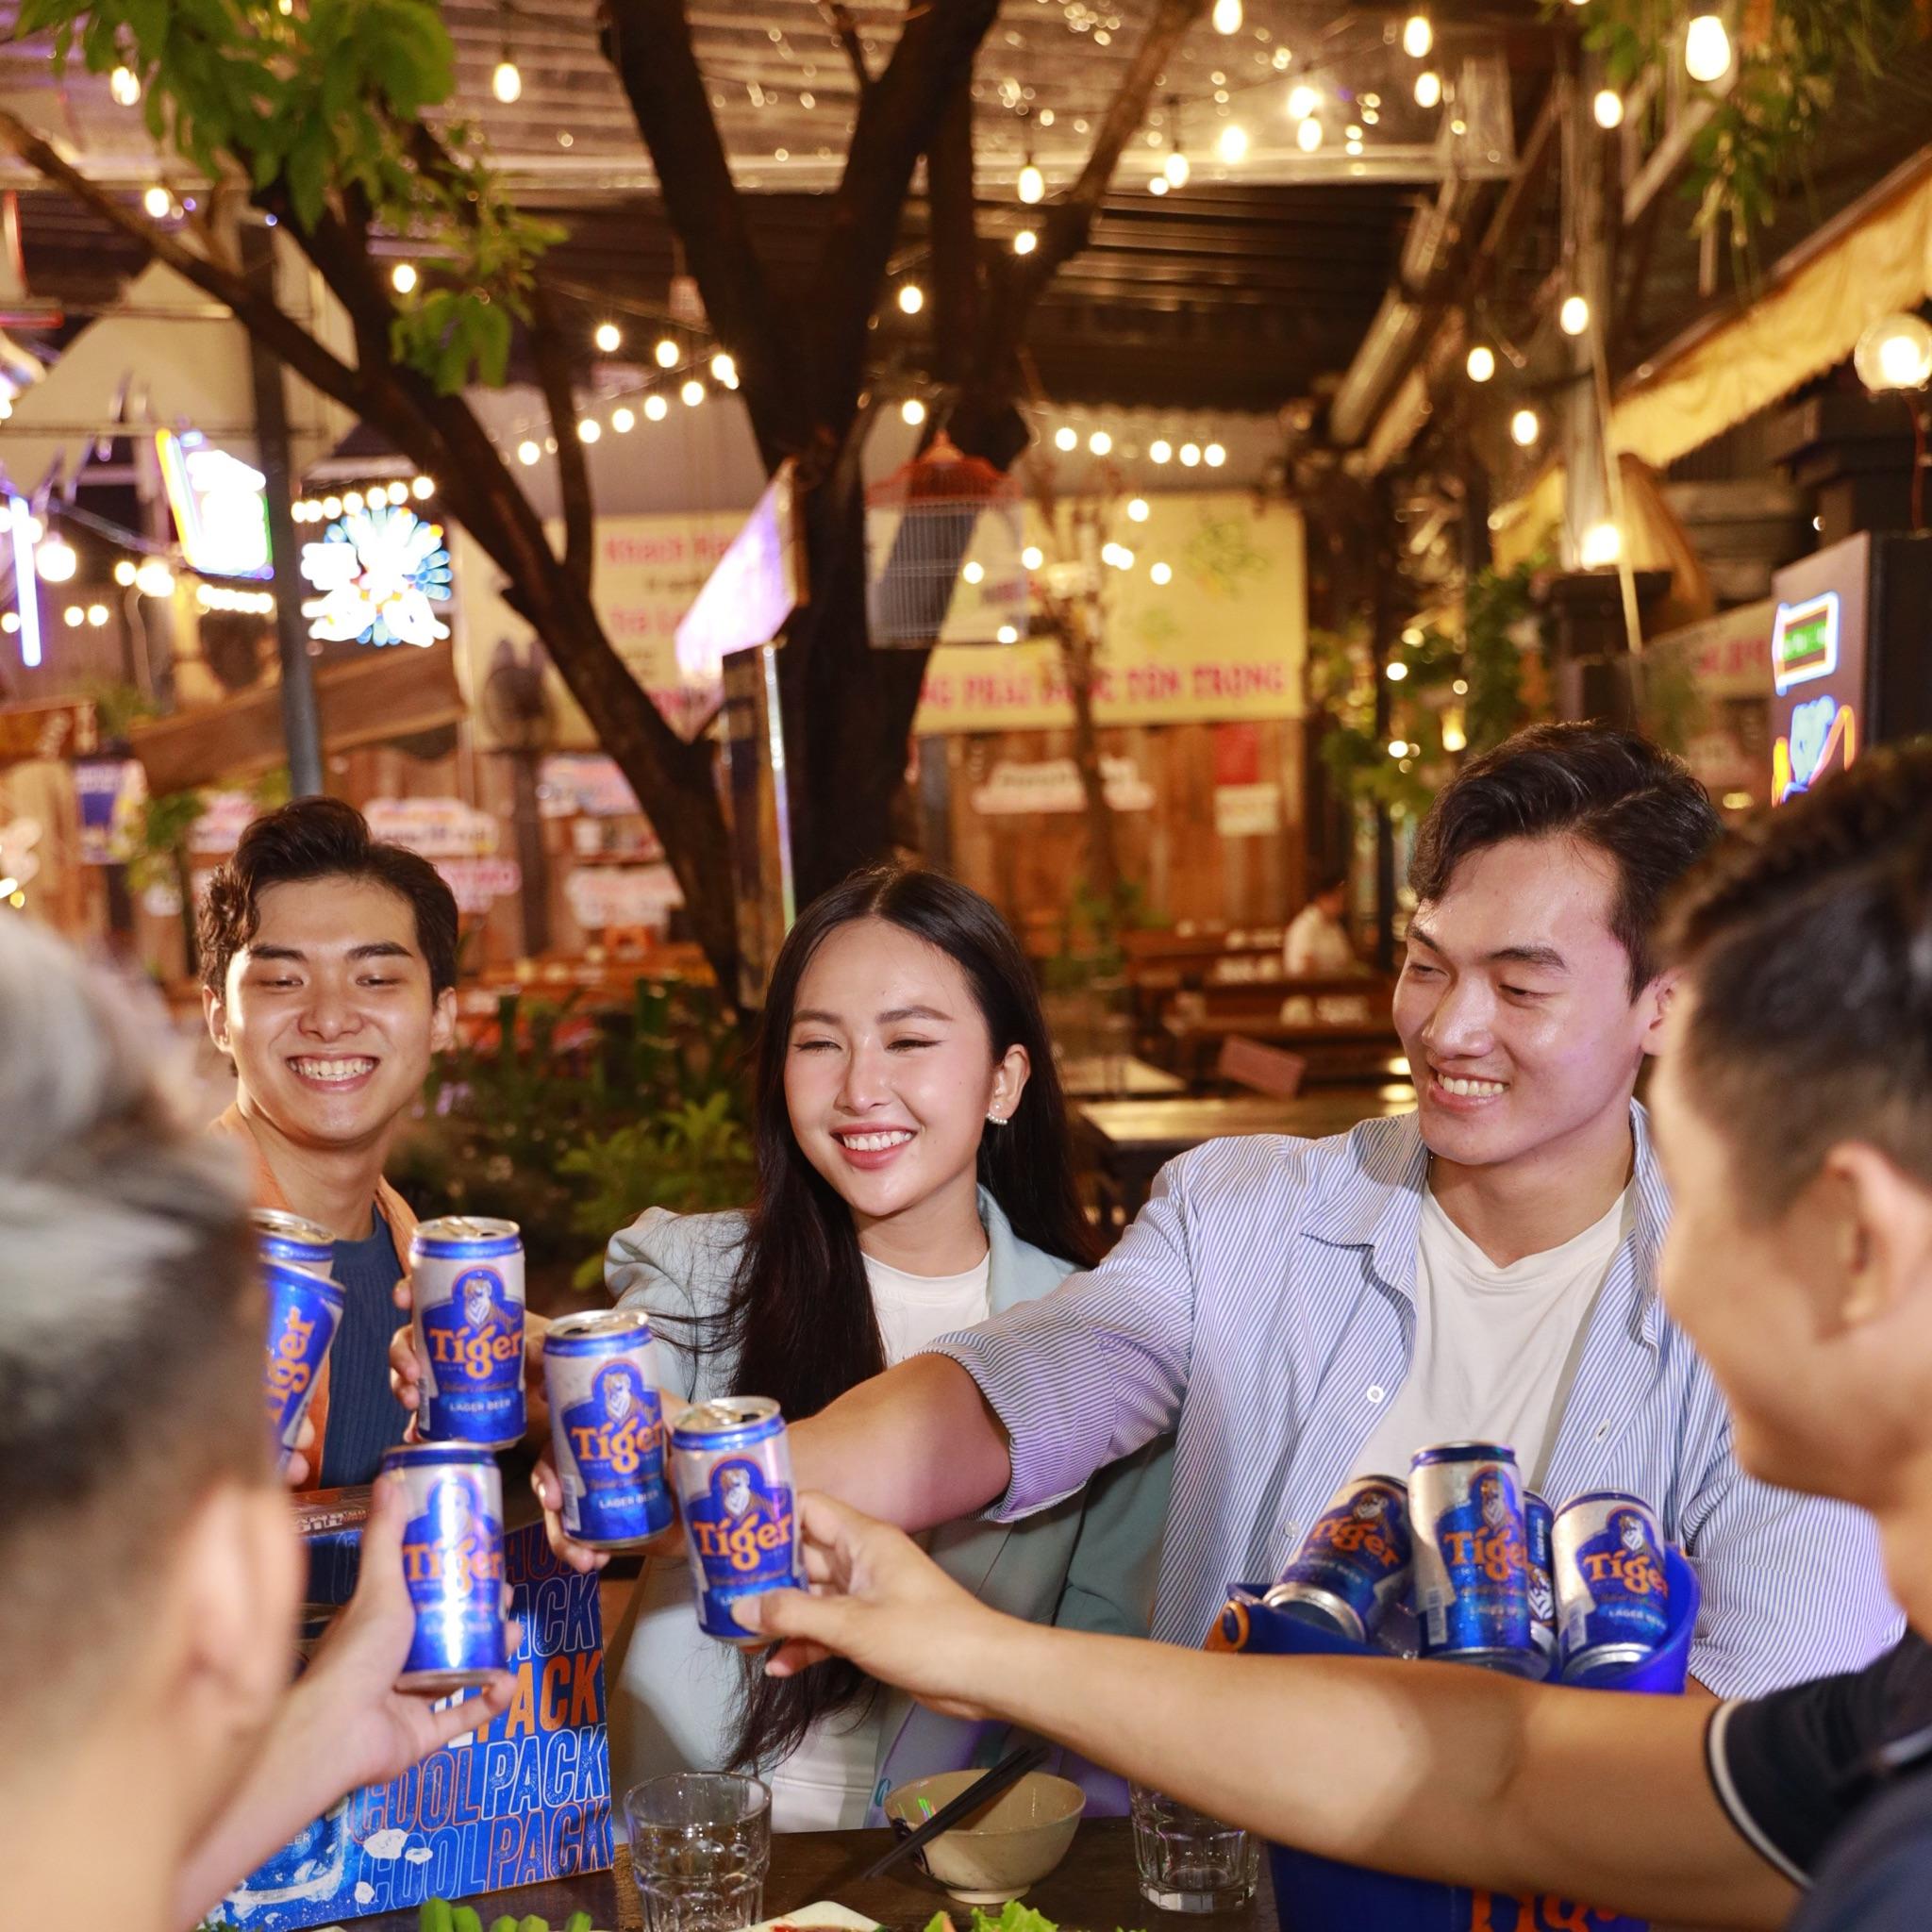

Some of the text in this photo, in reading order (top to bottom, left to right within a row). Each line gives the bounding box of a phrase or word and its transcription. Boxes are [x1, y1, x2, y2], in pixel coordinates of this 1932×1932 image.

[429, 1325, 524, 1379] Tiger
[449, 1402, 485, 1412] LAGER
[570, 1417, 663, 1474] Tiger
[598, 1495, 635, 1509] LAGER
[693, 1513, 792, 1571] Tiger
[508, 1571, 599, 1662] ACK
